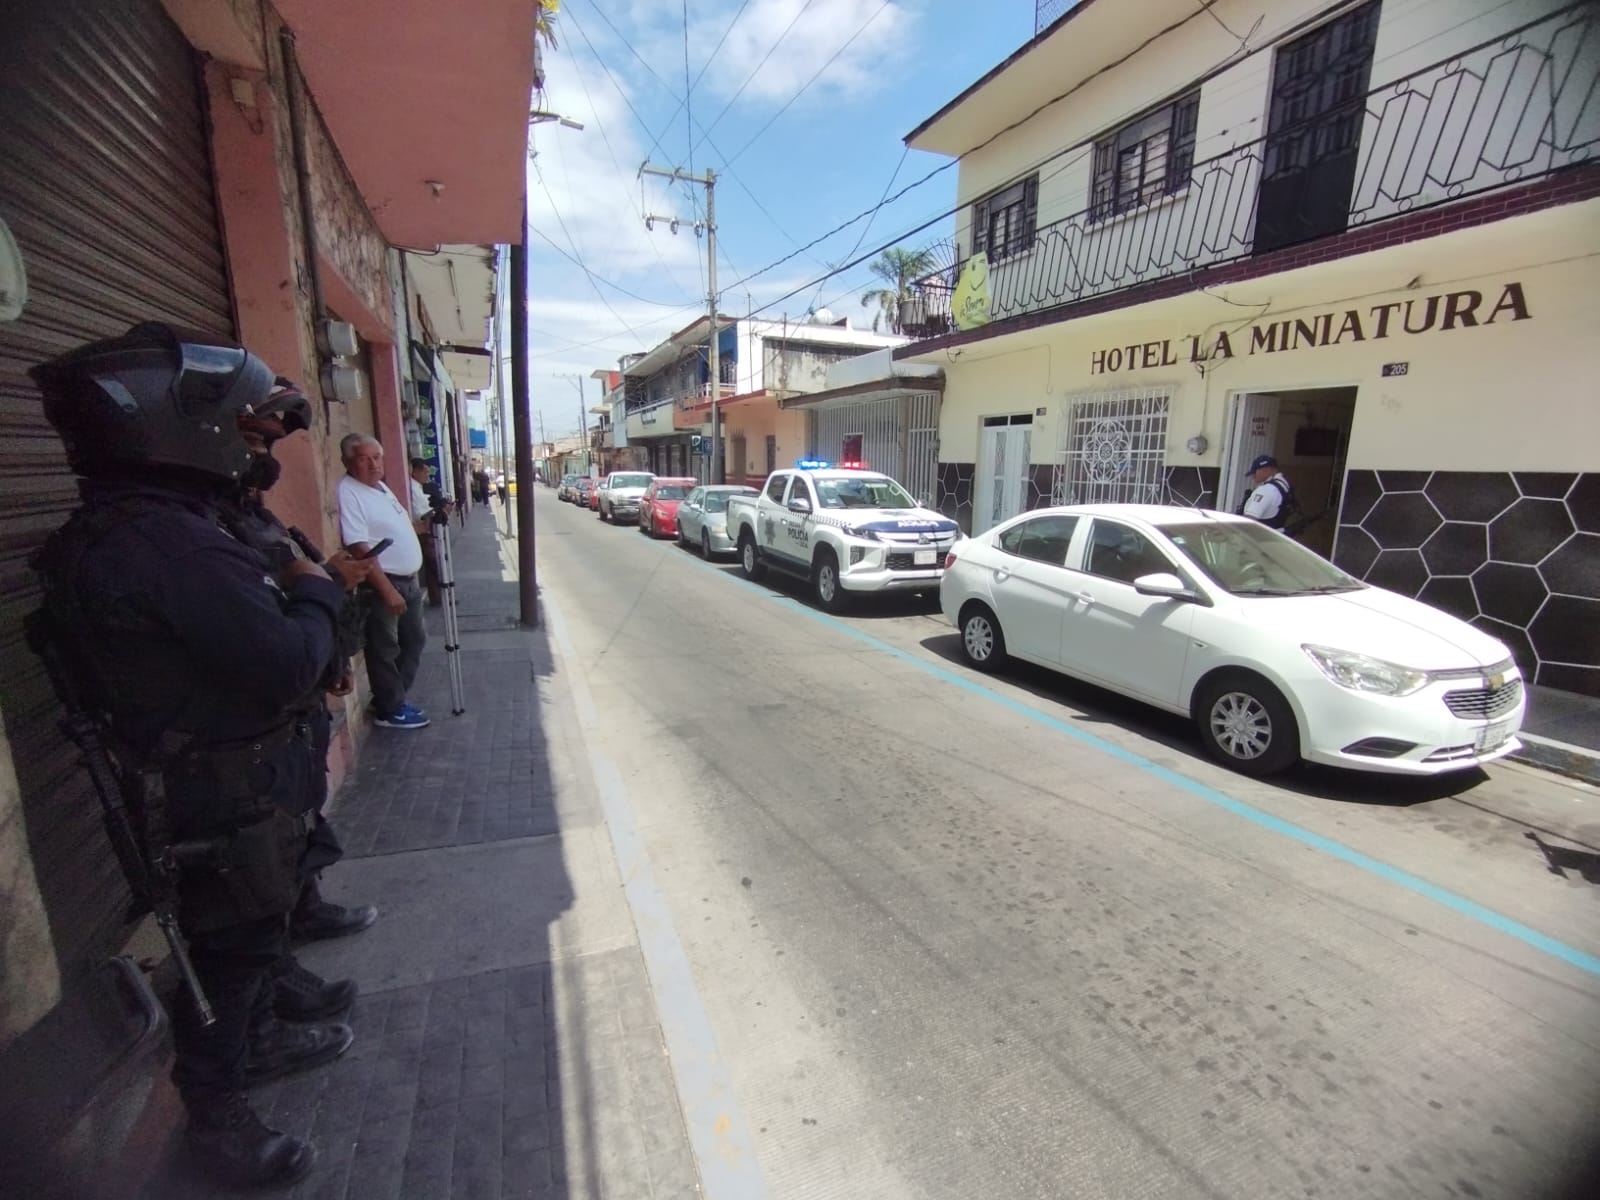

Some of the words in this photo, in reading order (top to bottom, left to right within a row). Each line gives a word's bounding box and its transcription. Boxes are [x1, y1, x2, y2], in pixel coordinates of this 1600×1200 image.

[1091, 340, 1177, 375] HOTEL
[1190, 331, 1234, 363] LA
[1249, 282, 1532, 355] MINIATURA
[1390, 363, 1407, 376] 205
